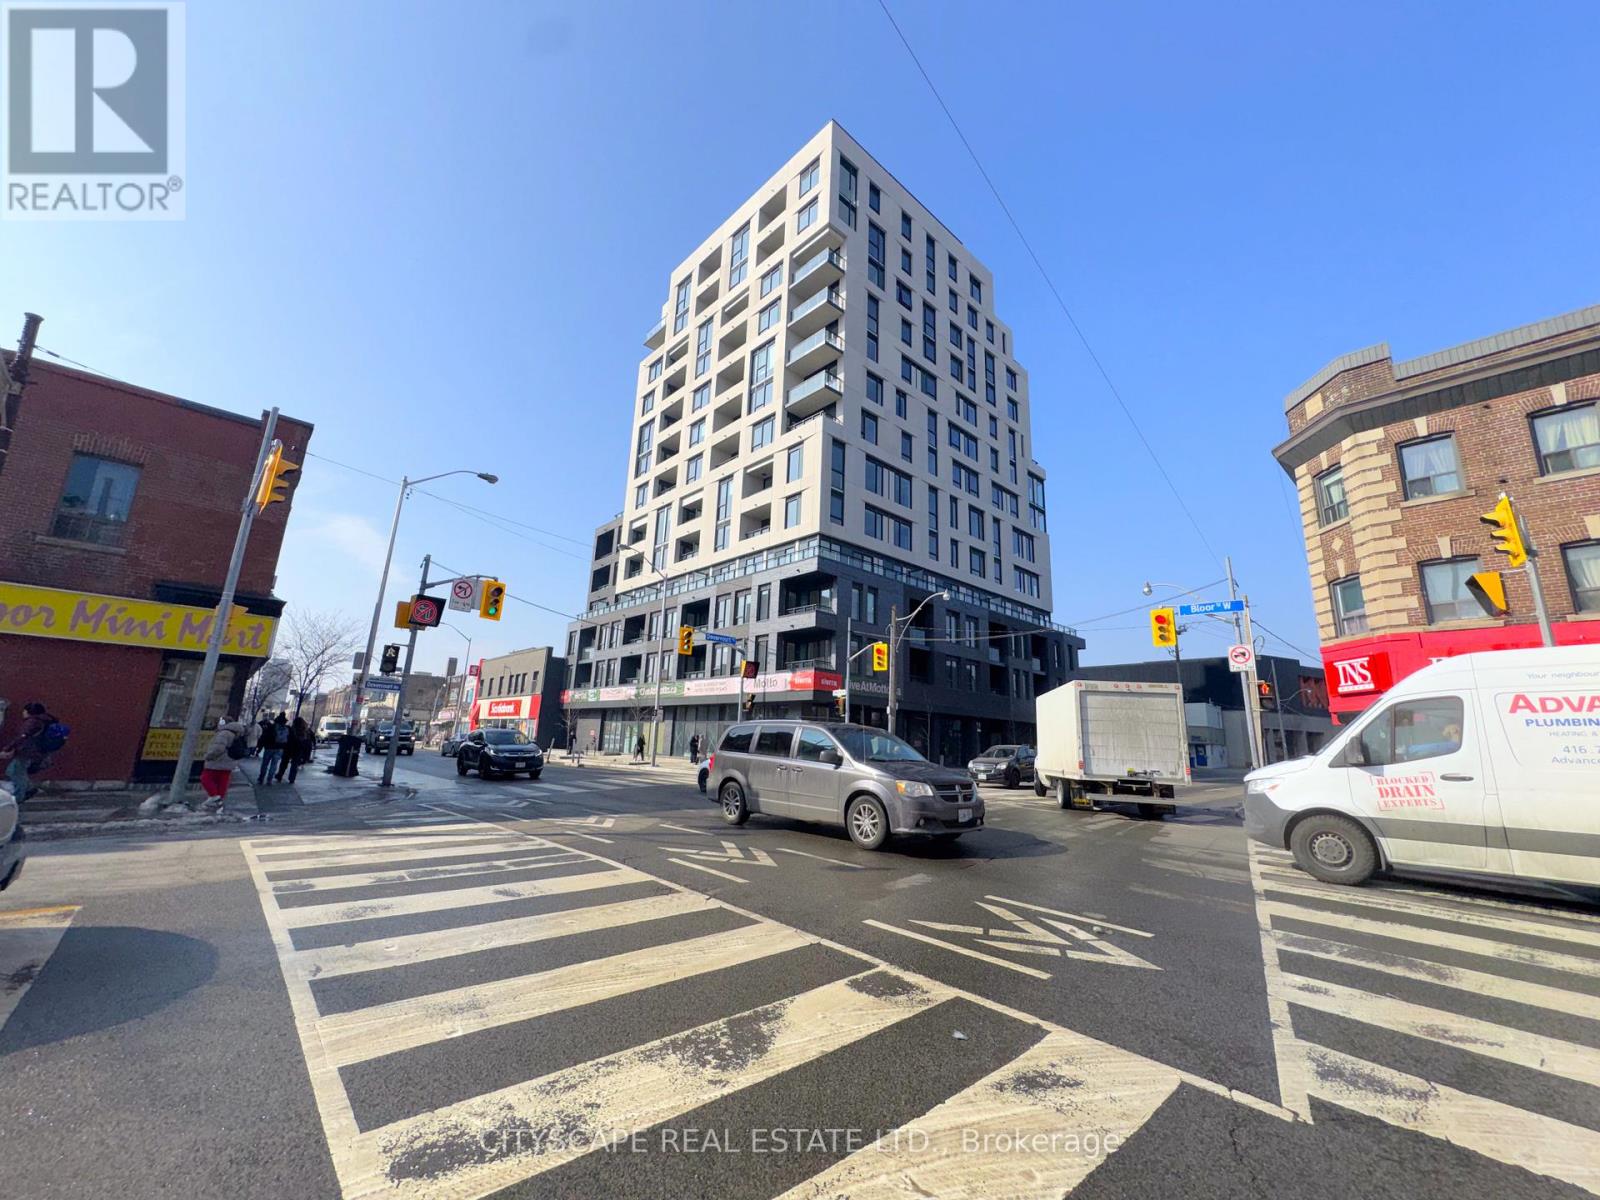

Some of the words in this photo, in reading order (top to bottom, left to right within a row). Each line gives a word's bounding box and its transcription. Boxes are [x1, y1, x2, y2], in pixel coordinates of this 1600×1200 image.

[1190, 603, 1215, 613] Bloor
[1222, 601, 1231, 610] W
[69, 599, 173, 640] Mini
[1333, 656, 1372, 687] INS
[1527, 672, 1547, 680] Your
[753, 677, 778, 690] Motto
[1562, 745, 1587, 754] 416
[1376, 775, 1430, 785] BLOCKED
[1377, 784, 1436, 799] DRAIN
[1382, 798, 1438, 808] EXPERTS
